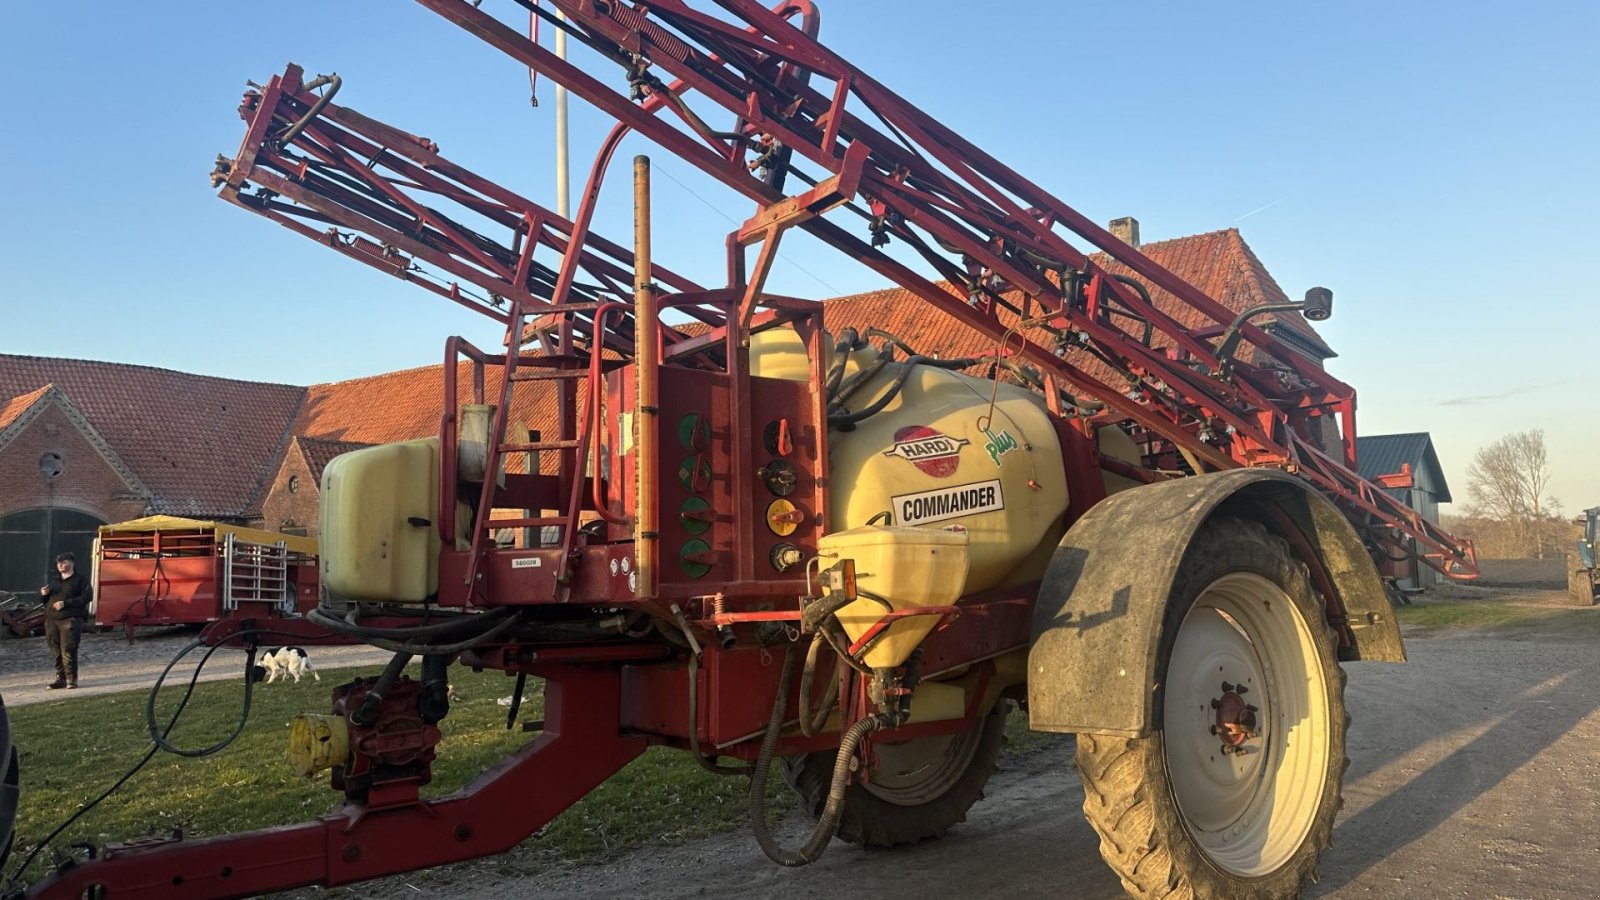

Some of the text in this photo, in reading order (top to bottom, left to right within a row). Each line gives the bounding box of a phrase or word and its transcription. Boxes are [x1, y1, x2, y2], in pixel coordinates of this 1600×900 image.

[901, 440, 954, 457] HARDI
[985, 428, 1017, 467] plus
[903, 486, 995, 521] COMMANDER
